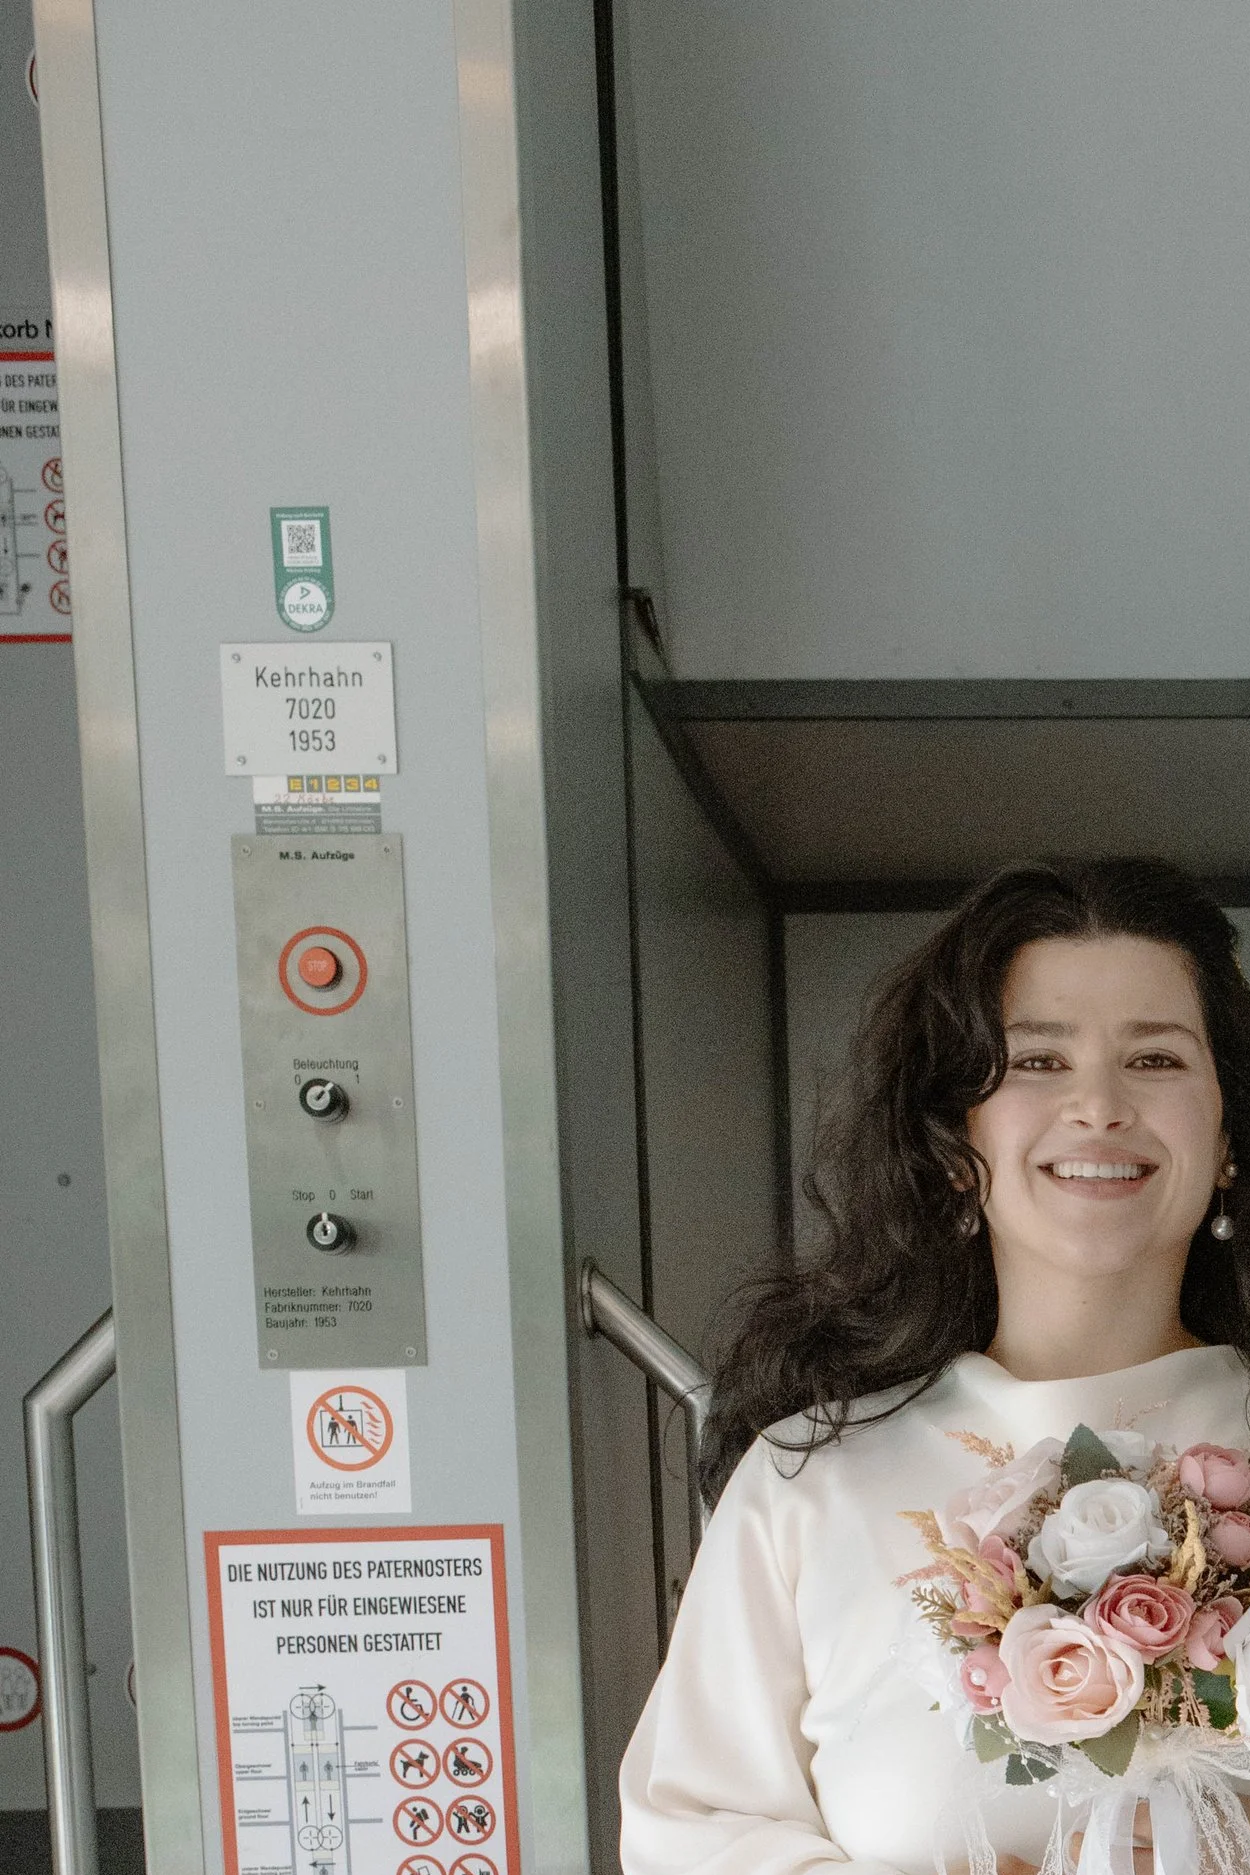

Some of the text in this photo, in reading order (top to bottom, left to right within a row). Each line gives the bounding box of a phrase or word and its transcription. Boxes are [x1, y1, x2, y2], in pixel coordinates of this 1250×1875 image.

[5, 374, 25, 387] DES
[288, 603, 324, 614] DEKRA
[255, 666, 363, 688] Kehrhahn
[286, 698, 336, 719] 7020
[289, 730, 336, 751] 1953
[279, 850, 355, 862] M.S. Aufzüge
[308, 959, 328, 972] STOP
[293, 1058, 359, 1071] Beleuchtung
[292, 1190, 316, 1202] Stop
[350, 1189, 374, 1200] Start
[264, 1286, 372, 1298] Hersteller: Kehrhahn
[265, 1301, 372, 1314] Fabriknummer: 7020
[265, 1317, 337, 1330] Baujahr: 1953
[310, 1480, 396, 1490] Aufzug im Brandfall
[310, 1491, 378, 1500] nicht benutzen!
[228, 1558, 482, 1582] DIE NUTZUNG DES PATERNOSTERS
[253, 1595, 467, 1618] IST NUR FÜR EINGEWIESENE
[277, 1632, 442, 1655] PERSONEN GESTATTET
